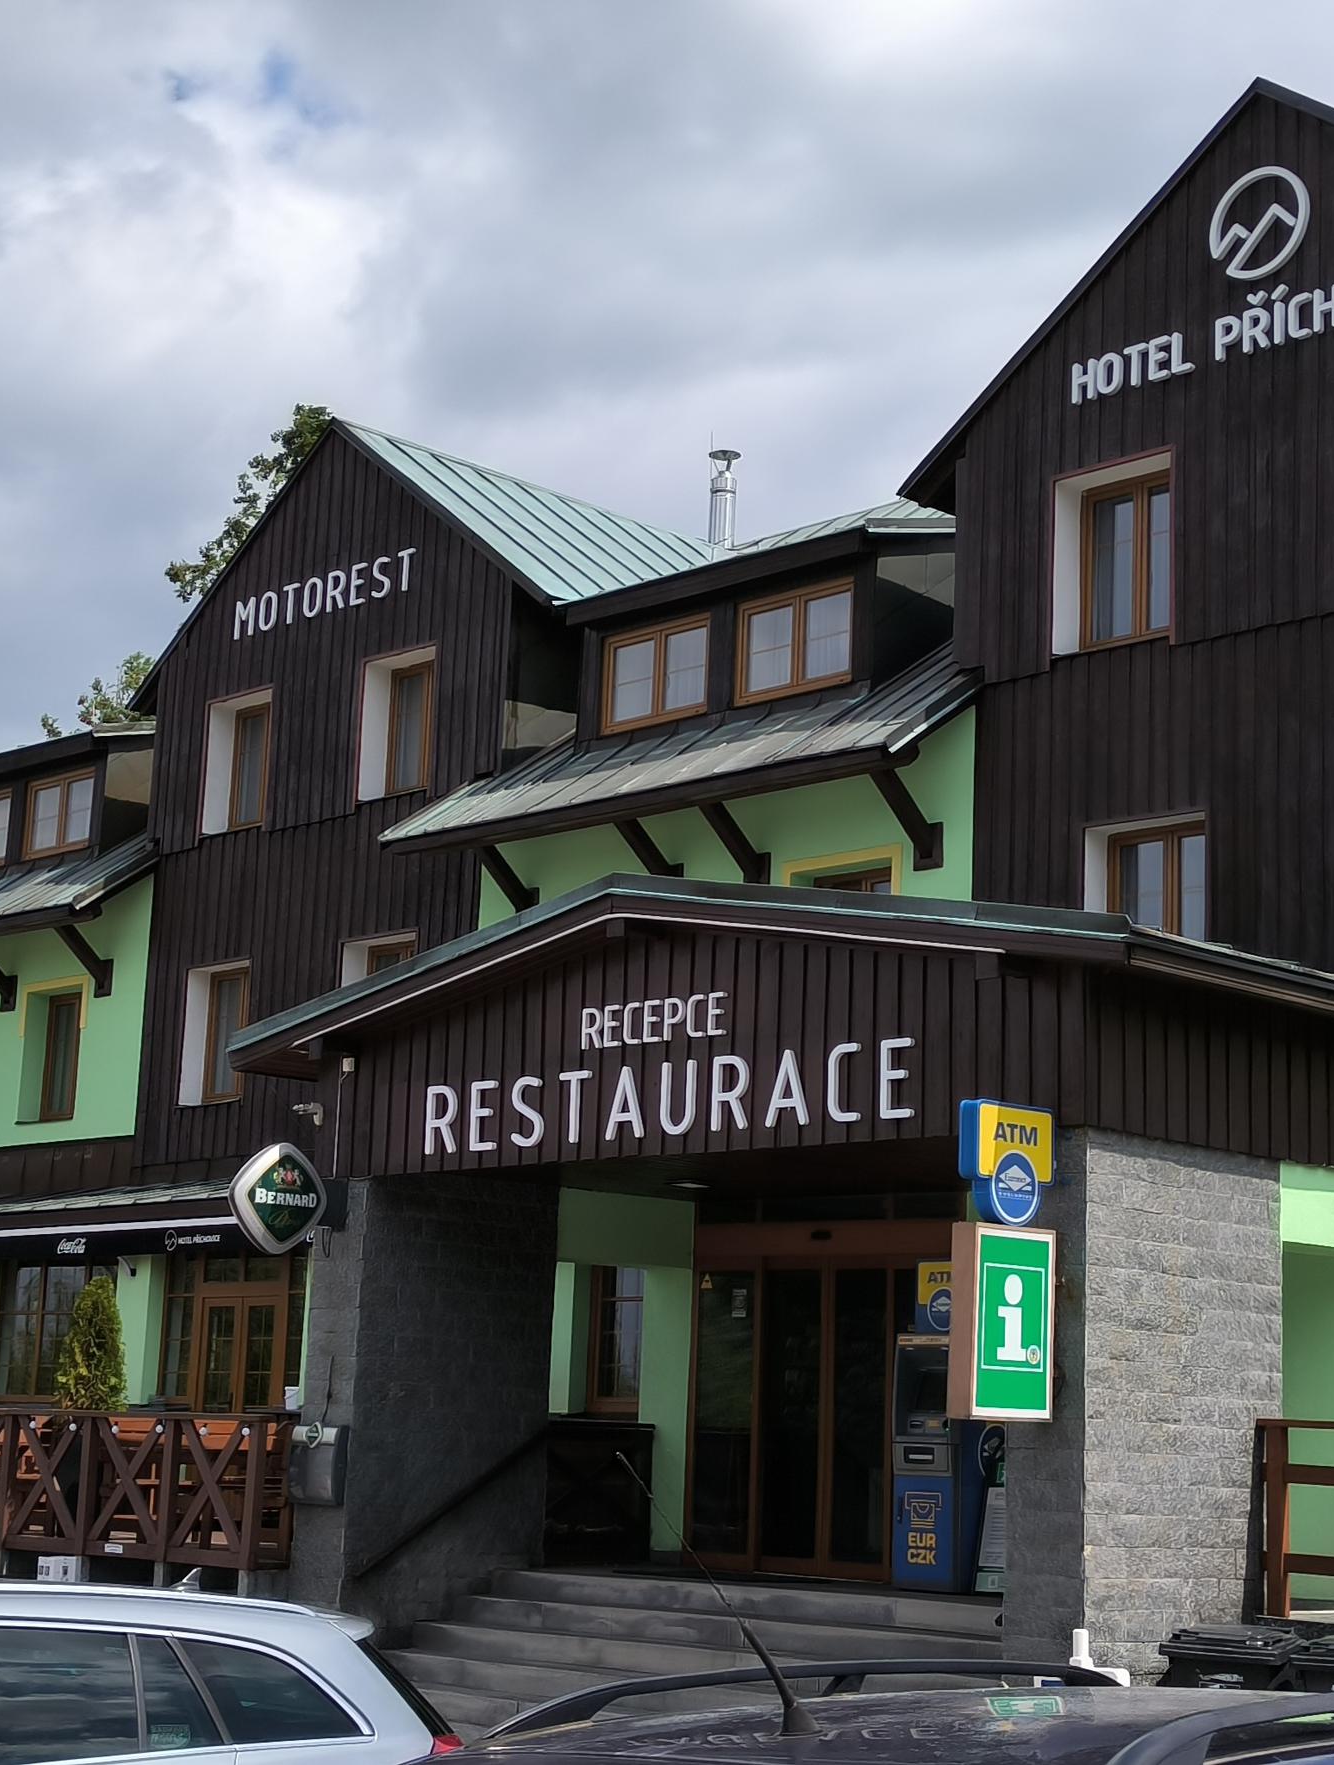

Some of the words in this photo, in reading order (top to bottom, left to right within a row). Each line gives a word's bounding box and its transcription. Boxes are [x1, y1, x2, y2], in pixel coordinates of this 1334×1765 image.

[1071, 332, 1196, 405] HOTEL
[233, 547, 417, 641] MOTOREST
[580, 991, 728, 1050] RECEPCE
[424, 1037, 916, 1155] RESTAURACE
[993, 1121, 1038, 1147] ATM
[254, 1188, 317, 1208] BERNARD
[907, 1531, 936, 1548] EUR
[907, 1549, 937, 1566] CZK
